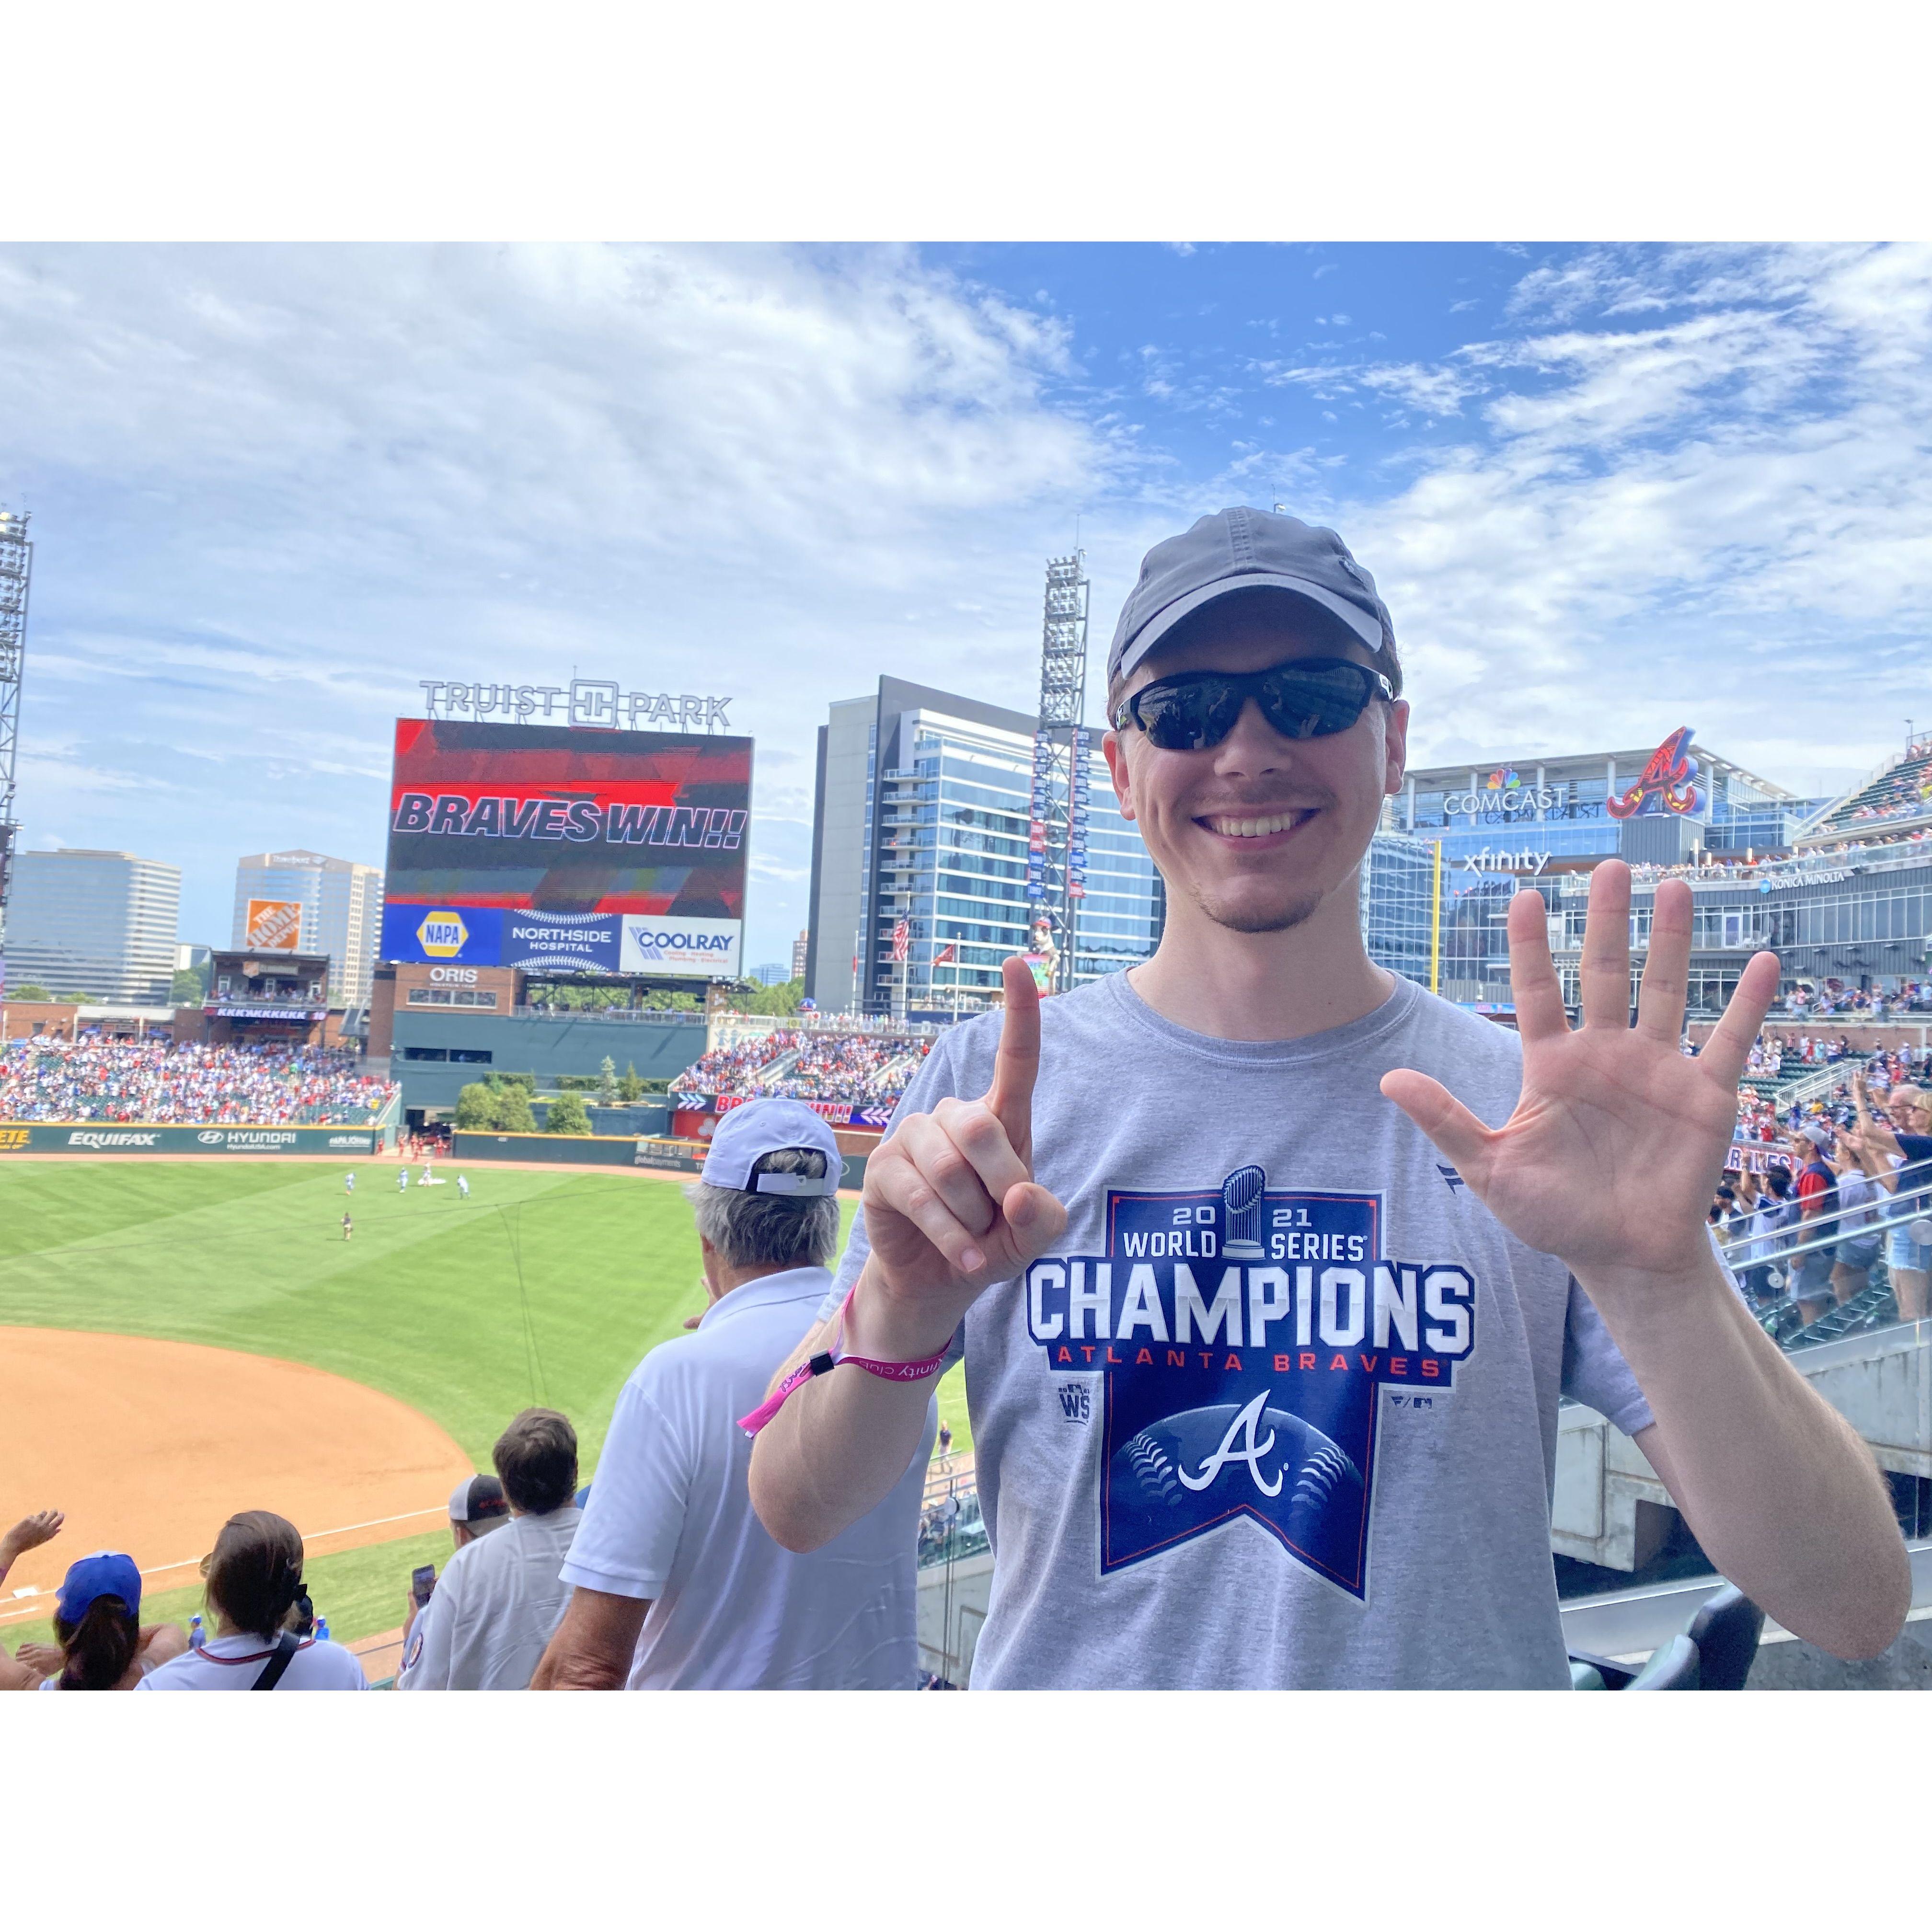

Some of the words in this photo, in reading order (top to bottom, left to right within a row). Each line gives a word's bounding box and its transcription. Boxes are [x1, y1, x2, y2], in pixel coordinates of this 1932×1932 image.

[420, 680, 561, 715] TRUIST
[628, 691, 733, 726] PARK
[1444, 787, 1566, 815] COMCAST
[393, 793, 600, 842] BRAVES
[606, 803, 748, 849] WIN!!
[1463, 845, 1552, 877] xfinity
[1771, 875, 1804, 890] KONICA
[1806, 872, 1845, 886] MINOLTA
[253, 905, 276, 924] THE
[247, 903, 298, 947] HOME
[425, 924, 460, 944] NAPA
[512, 927, 612, 943] NORTHSIDE
[530, 942, 593, 953] HOSPITAL
[638, 932, 735, 951] COOLRAY
[430, 967, 478, 983] ORIS
[68, 1131, 156, 1149] EQUIFAX
[227, 1132, 296, 1144] HYUNDAI
[634, 1155, 681, 1168] globalpayments
[1173, 1206, 1216, 1226] 20
[1272, 1208, 1312, 1228] 21
[1123, 1230, 1216, 1258] WORLD
[1271, 1232, 1364, 1262] SERIES
[1030, 1262, 1471, 1354] CHAMPIONS
[859, 1360, 894, 1375] club
[1058, 1345, 1243, 1371] ATLANTA
[1274, 1352, 1439, 1378] BRAVES
[1059, 1393, 1090, 1419] WS
